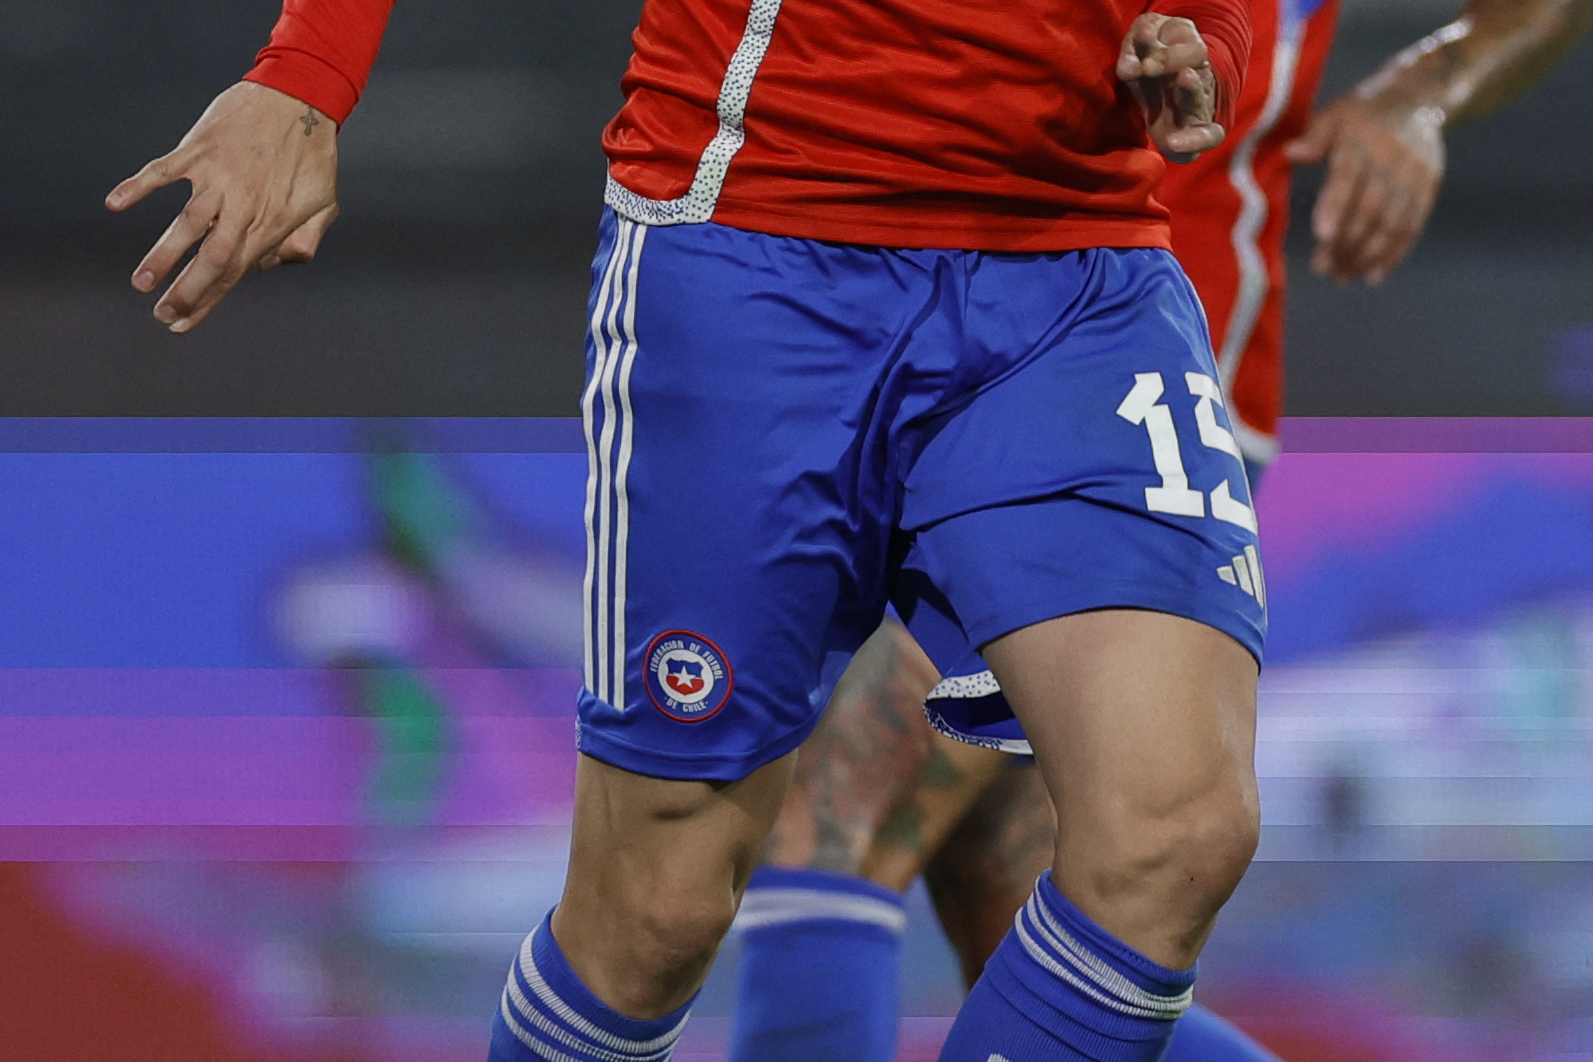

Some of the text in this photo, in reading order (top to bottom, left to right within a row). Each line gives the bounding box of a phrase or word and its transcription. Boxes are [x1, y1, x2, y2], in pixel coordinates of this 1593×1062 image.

[1116, 370, 1259, 536] 15
[689, 642, 702, 654] DE
[666, 698, 707, 713] DE CHILE
